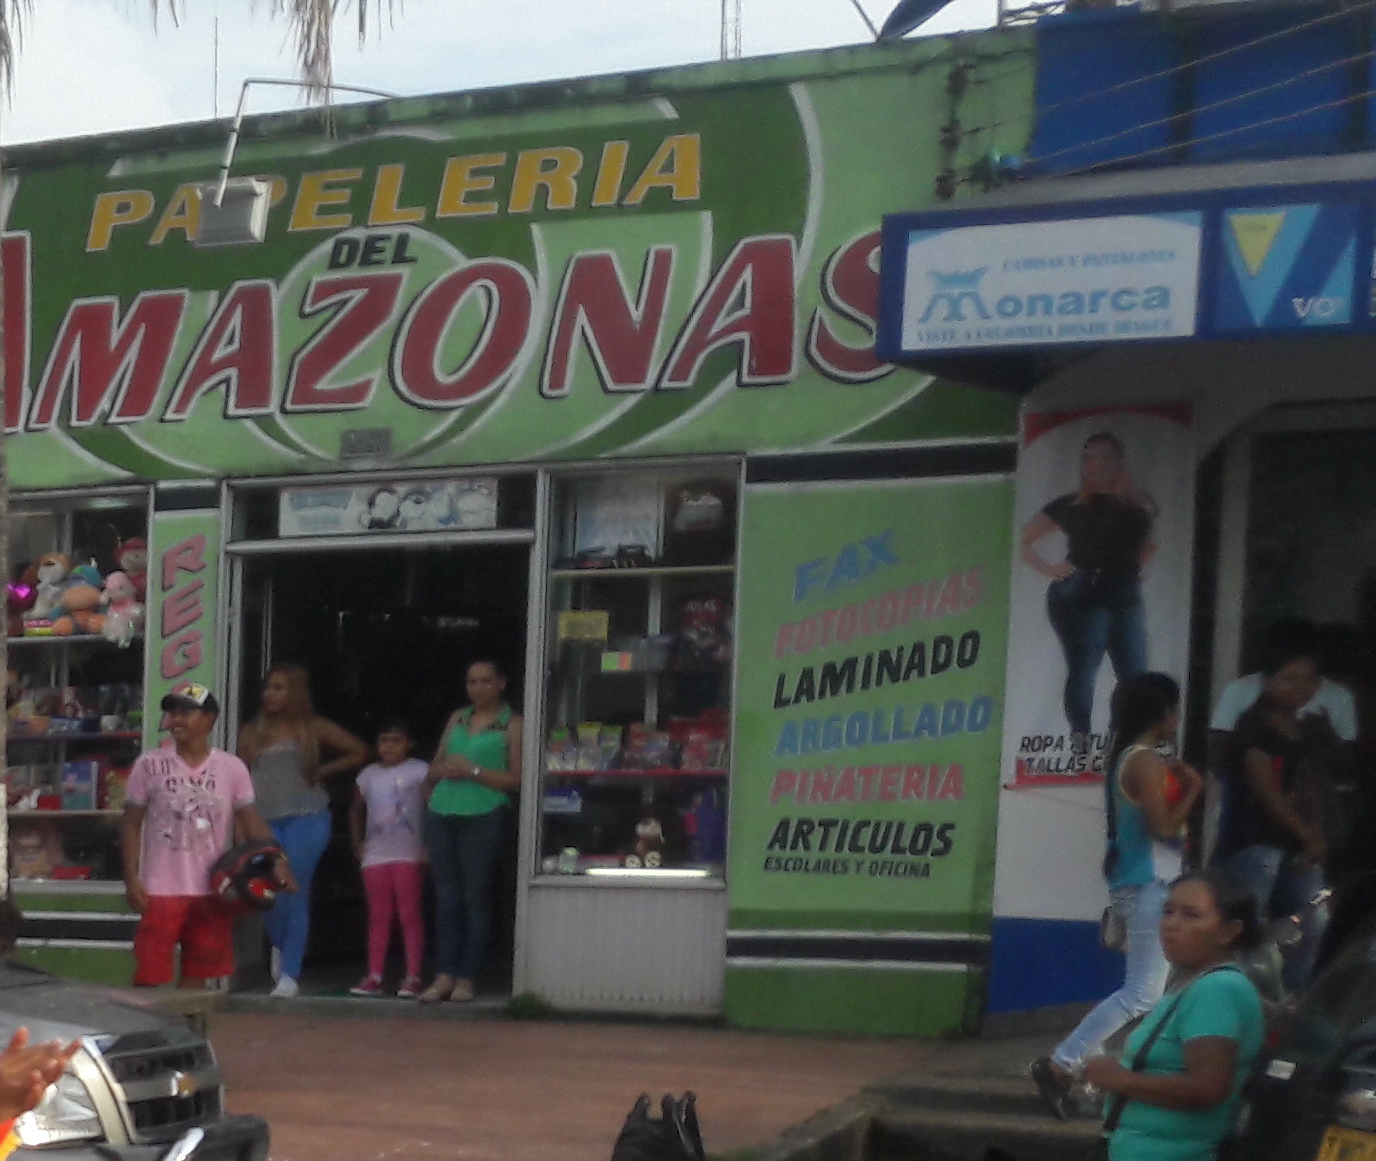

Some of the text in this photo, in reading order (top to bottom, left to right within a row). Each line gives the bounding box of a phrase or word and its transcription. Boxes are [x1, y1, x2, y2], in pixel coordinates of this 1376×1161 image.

[85, 133, 702, 252] PAELERIA
[328, 232, 418, 270] DEL
[918, 272, 1172, 323] Monarca
[793, 529, 901, 602] FAX
[774, 564, 988, 660] FOTOCOPIAS
[773, 629, 982, 710] LAMINADO
[774, 694, 995, 759] ARGOLLADO
[766, 816, 957, 858] ARTICULOS
[852, 859, 865, 876] Y
